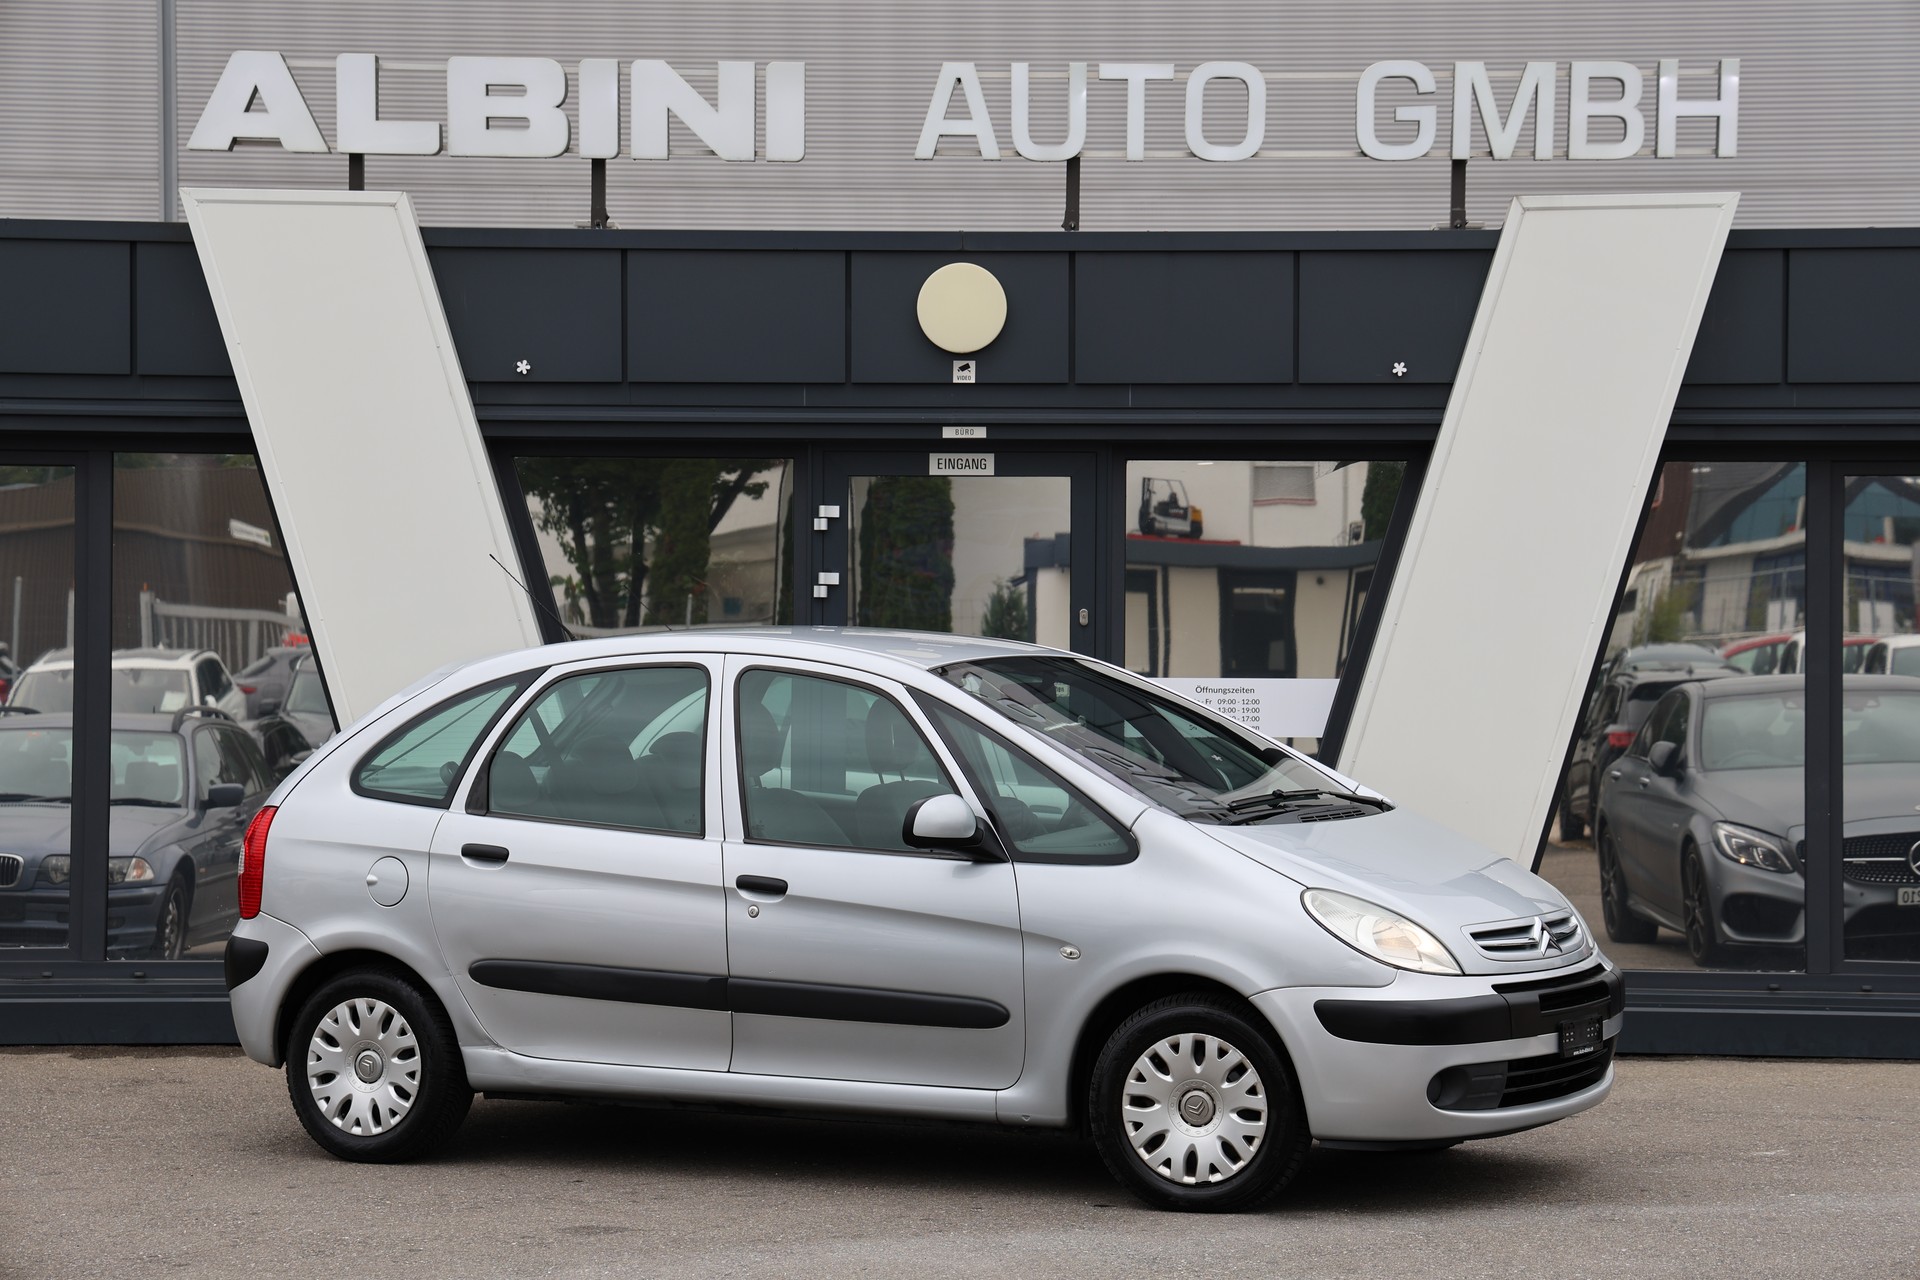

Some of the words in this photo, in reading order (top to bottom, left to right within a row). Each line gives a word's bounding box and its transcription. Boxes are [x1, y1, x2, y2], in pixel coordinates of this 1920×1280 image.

[186, 50, 806, 162] ALBINI
[915, 60, 1267, 162] AUTO
[1355, 58, 1741, 162] GMBH
[954, 427, 975, 436] BÜRO
[937, 457, 987, 470] EINGANG
[1195, 685, 1255, 695] Öffnungszeiten
